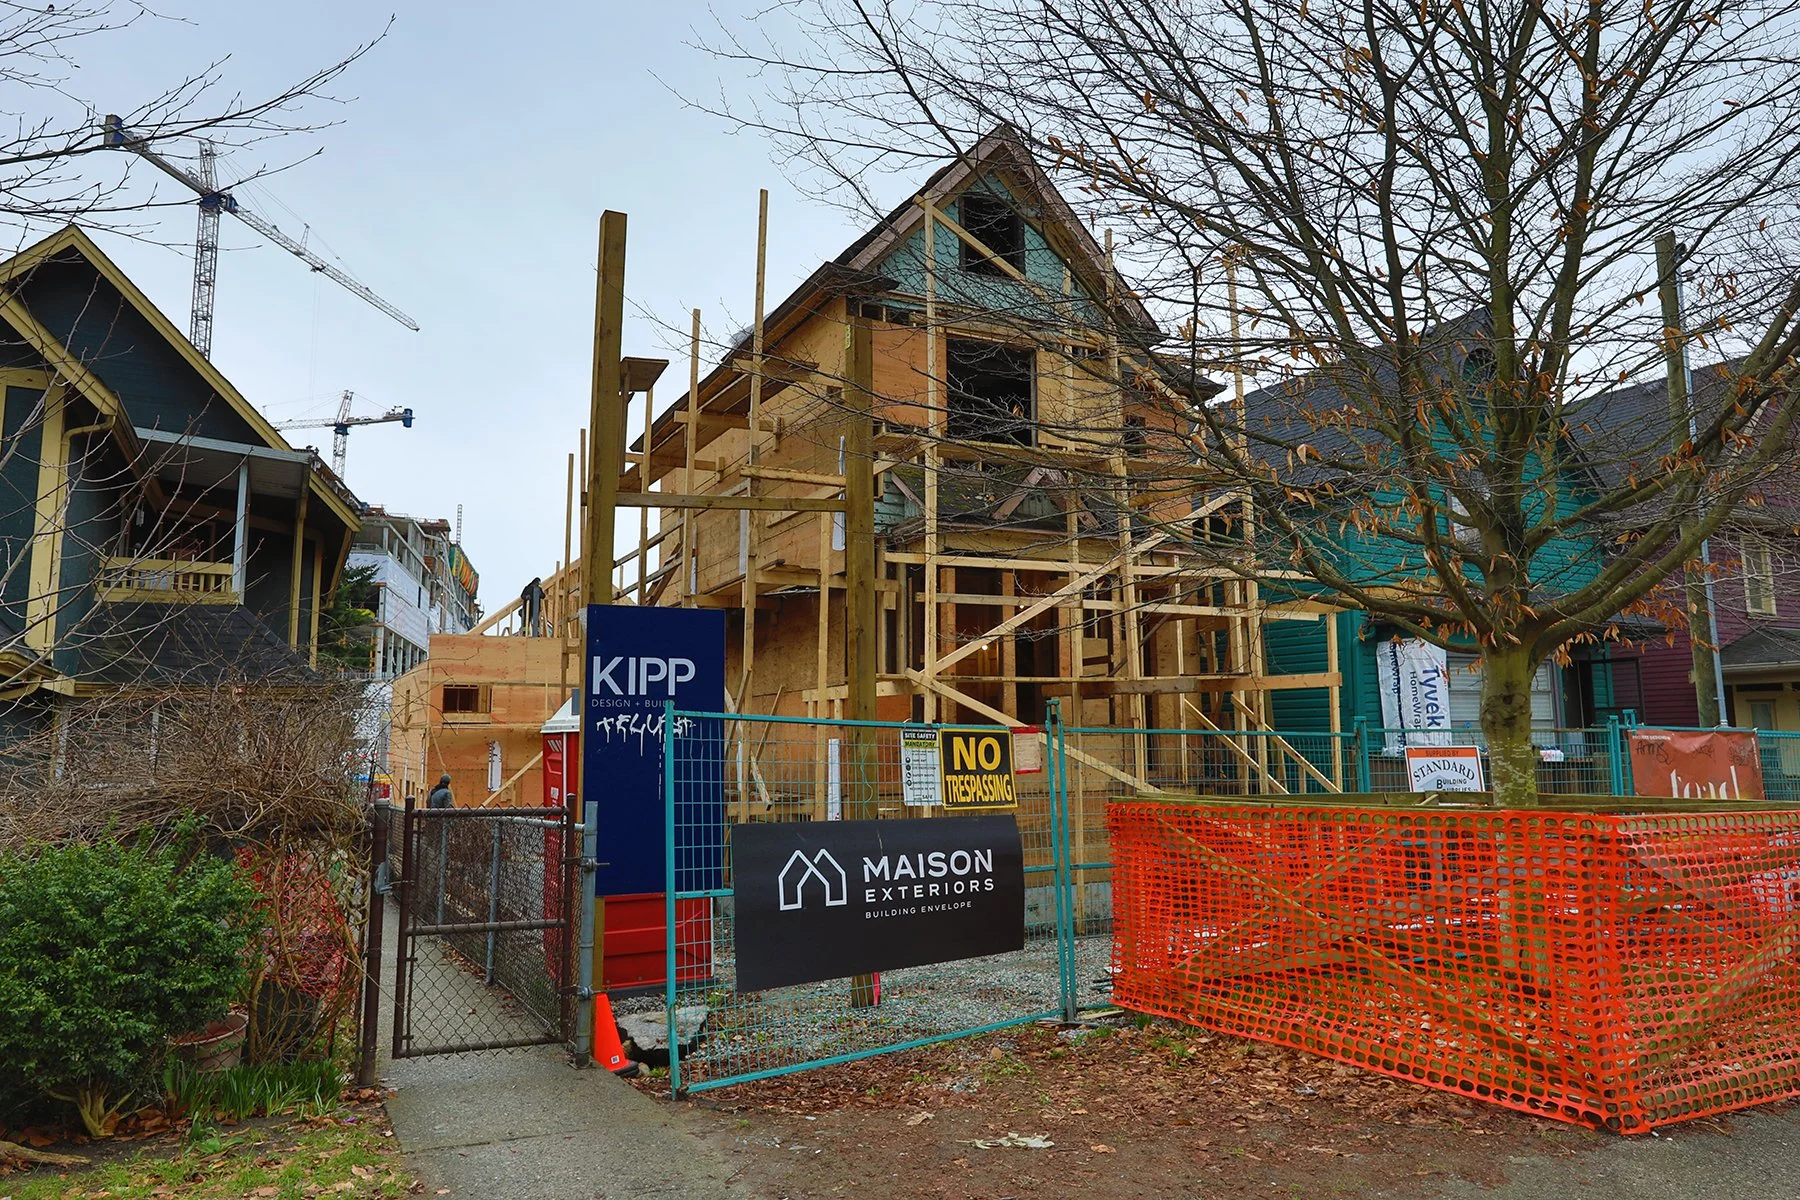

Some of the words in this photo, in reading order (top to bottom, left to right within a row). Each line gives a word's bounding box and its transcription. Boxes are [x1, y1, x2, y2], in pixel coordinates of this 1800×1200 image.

[592, 656, 696, 696] KIPP
[591, 699, 631, 708] DESIGN
[1418, 665, 1445, 728] Tyvek
[952, 736, 1001, 771] NO
[1413, 759, 1475, 782] STANDARD
[946, 774, 1012, 803] TRESPASSING
[862, 849, 993, 883] MAISON
[865, 878, 995, 903] EXTERIORS
[865, 907, 917, 919] BUILDING
[921, 901, 972, 913] ENVELOPE
